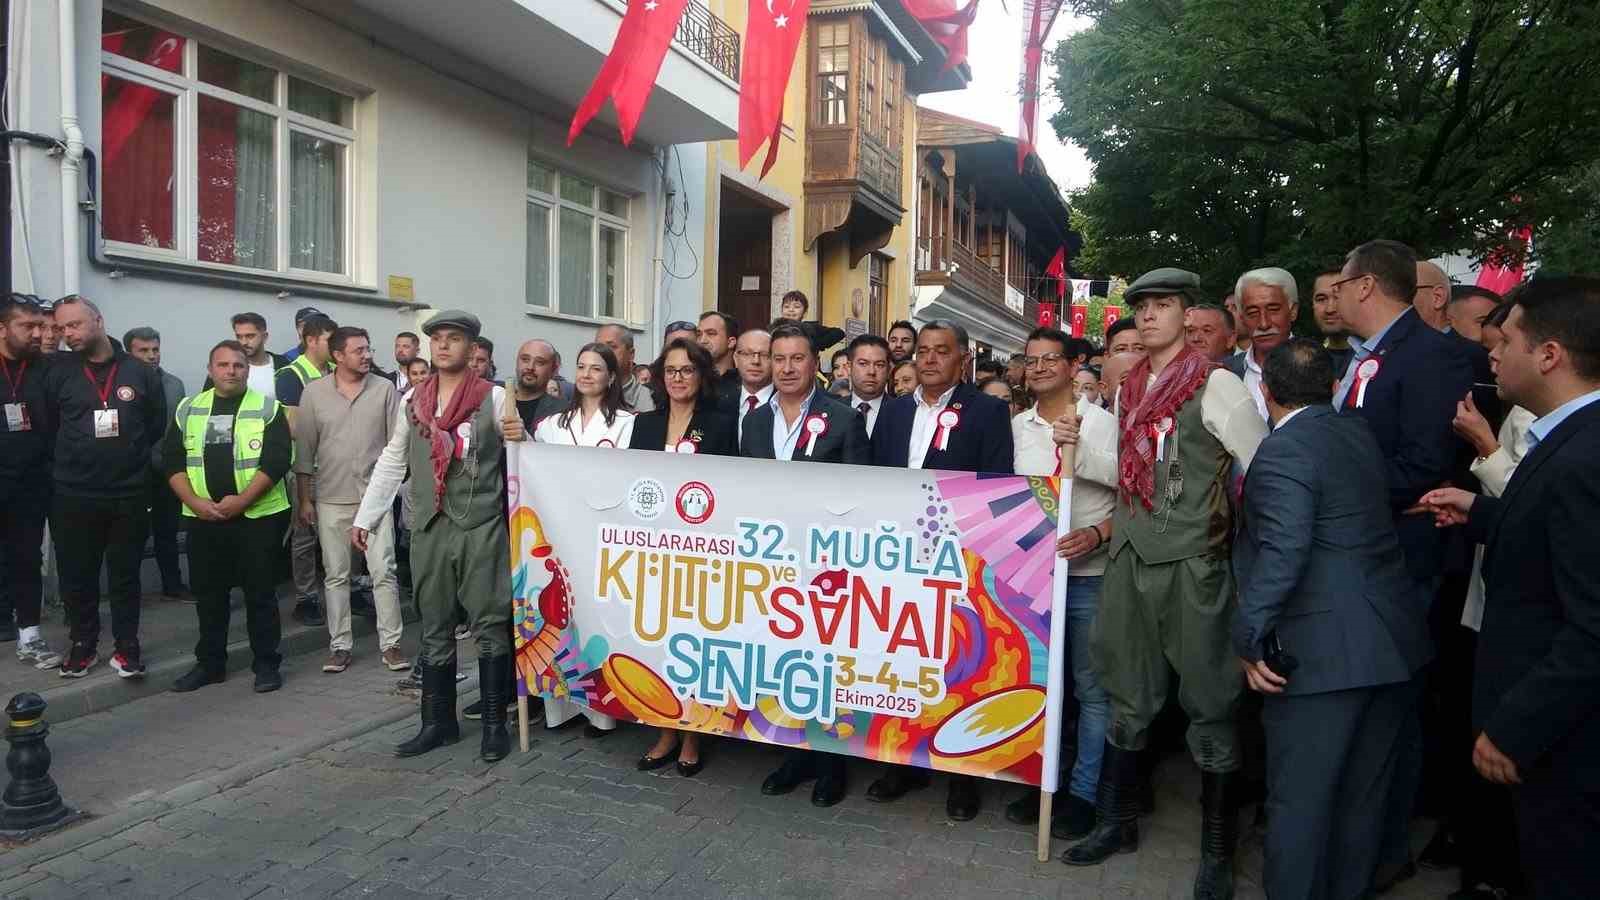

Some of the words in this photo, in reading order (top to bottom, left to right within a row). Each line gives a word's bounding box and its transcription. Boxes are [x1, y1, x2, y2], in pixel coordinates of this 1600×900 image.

[602, 527, 735, 556] ULUSLARARASI
[739, 522, 796, 561] 32.
[810, 523, 962, 579] MUĞLA
[772, 565, 797, 584] ve
[597, 549, 771, 642] KÜLTÜR
[769, 574, 963, 660] SANAT
[835, 655, 940, 698] 3-4-5
[835, 688, 874, 707] Ekim
[876, 693, 917, 713] 2025
